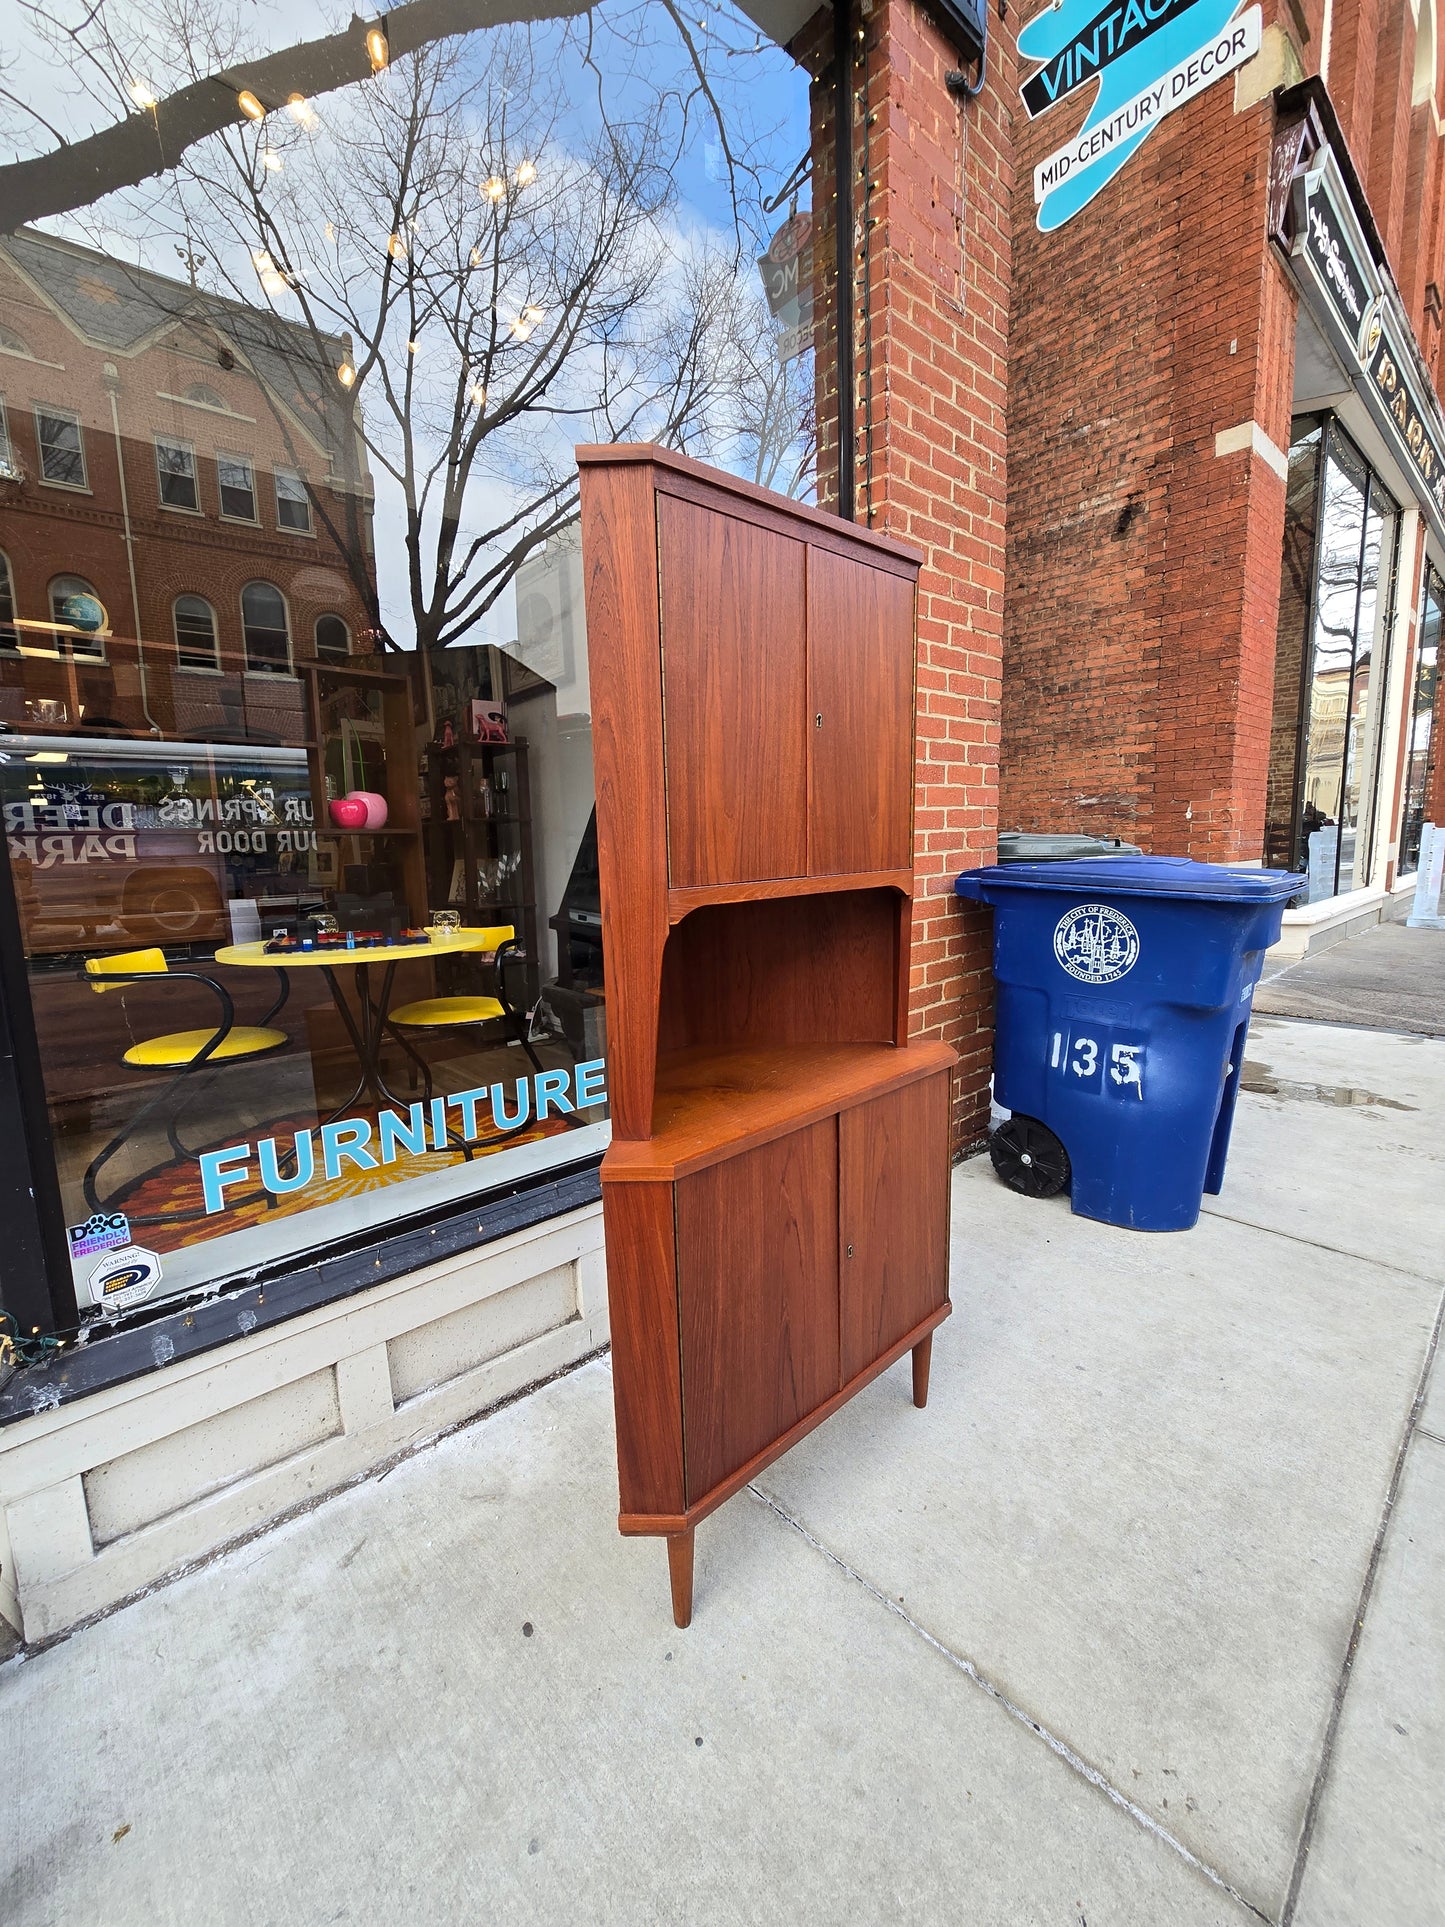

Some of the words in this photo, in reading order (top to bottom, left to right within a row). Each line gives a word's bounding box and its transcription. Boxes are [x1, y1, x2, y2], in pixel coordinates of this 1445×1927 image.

[1041, 0, 1178, 100] VINTA
[1041, 81, 1167, 191] MID-CENTURY
[1172, 28, 1247, 99] DECOR
[1060, 916, 1073, 930] THE
[1070, 907, 1087, 919] CITY
[1100, 907, 1135, 937] FREDERICK
[1064, 962, 1103, 981] FOUNDED
[1104, 968, 1122, 981] 1745
[1051, 1032, 1142, 1088] 135
[198, 1057, 609, 1215] FURNITURE
[71, 1228, 127, 1251] FRIENDLY
[73, 1235, 130, 1259] FREDERICK
